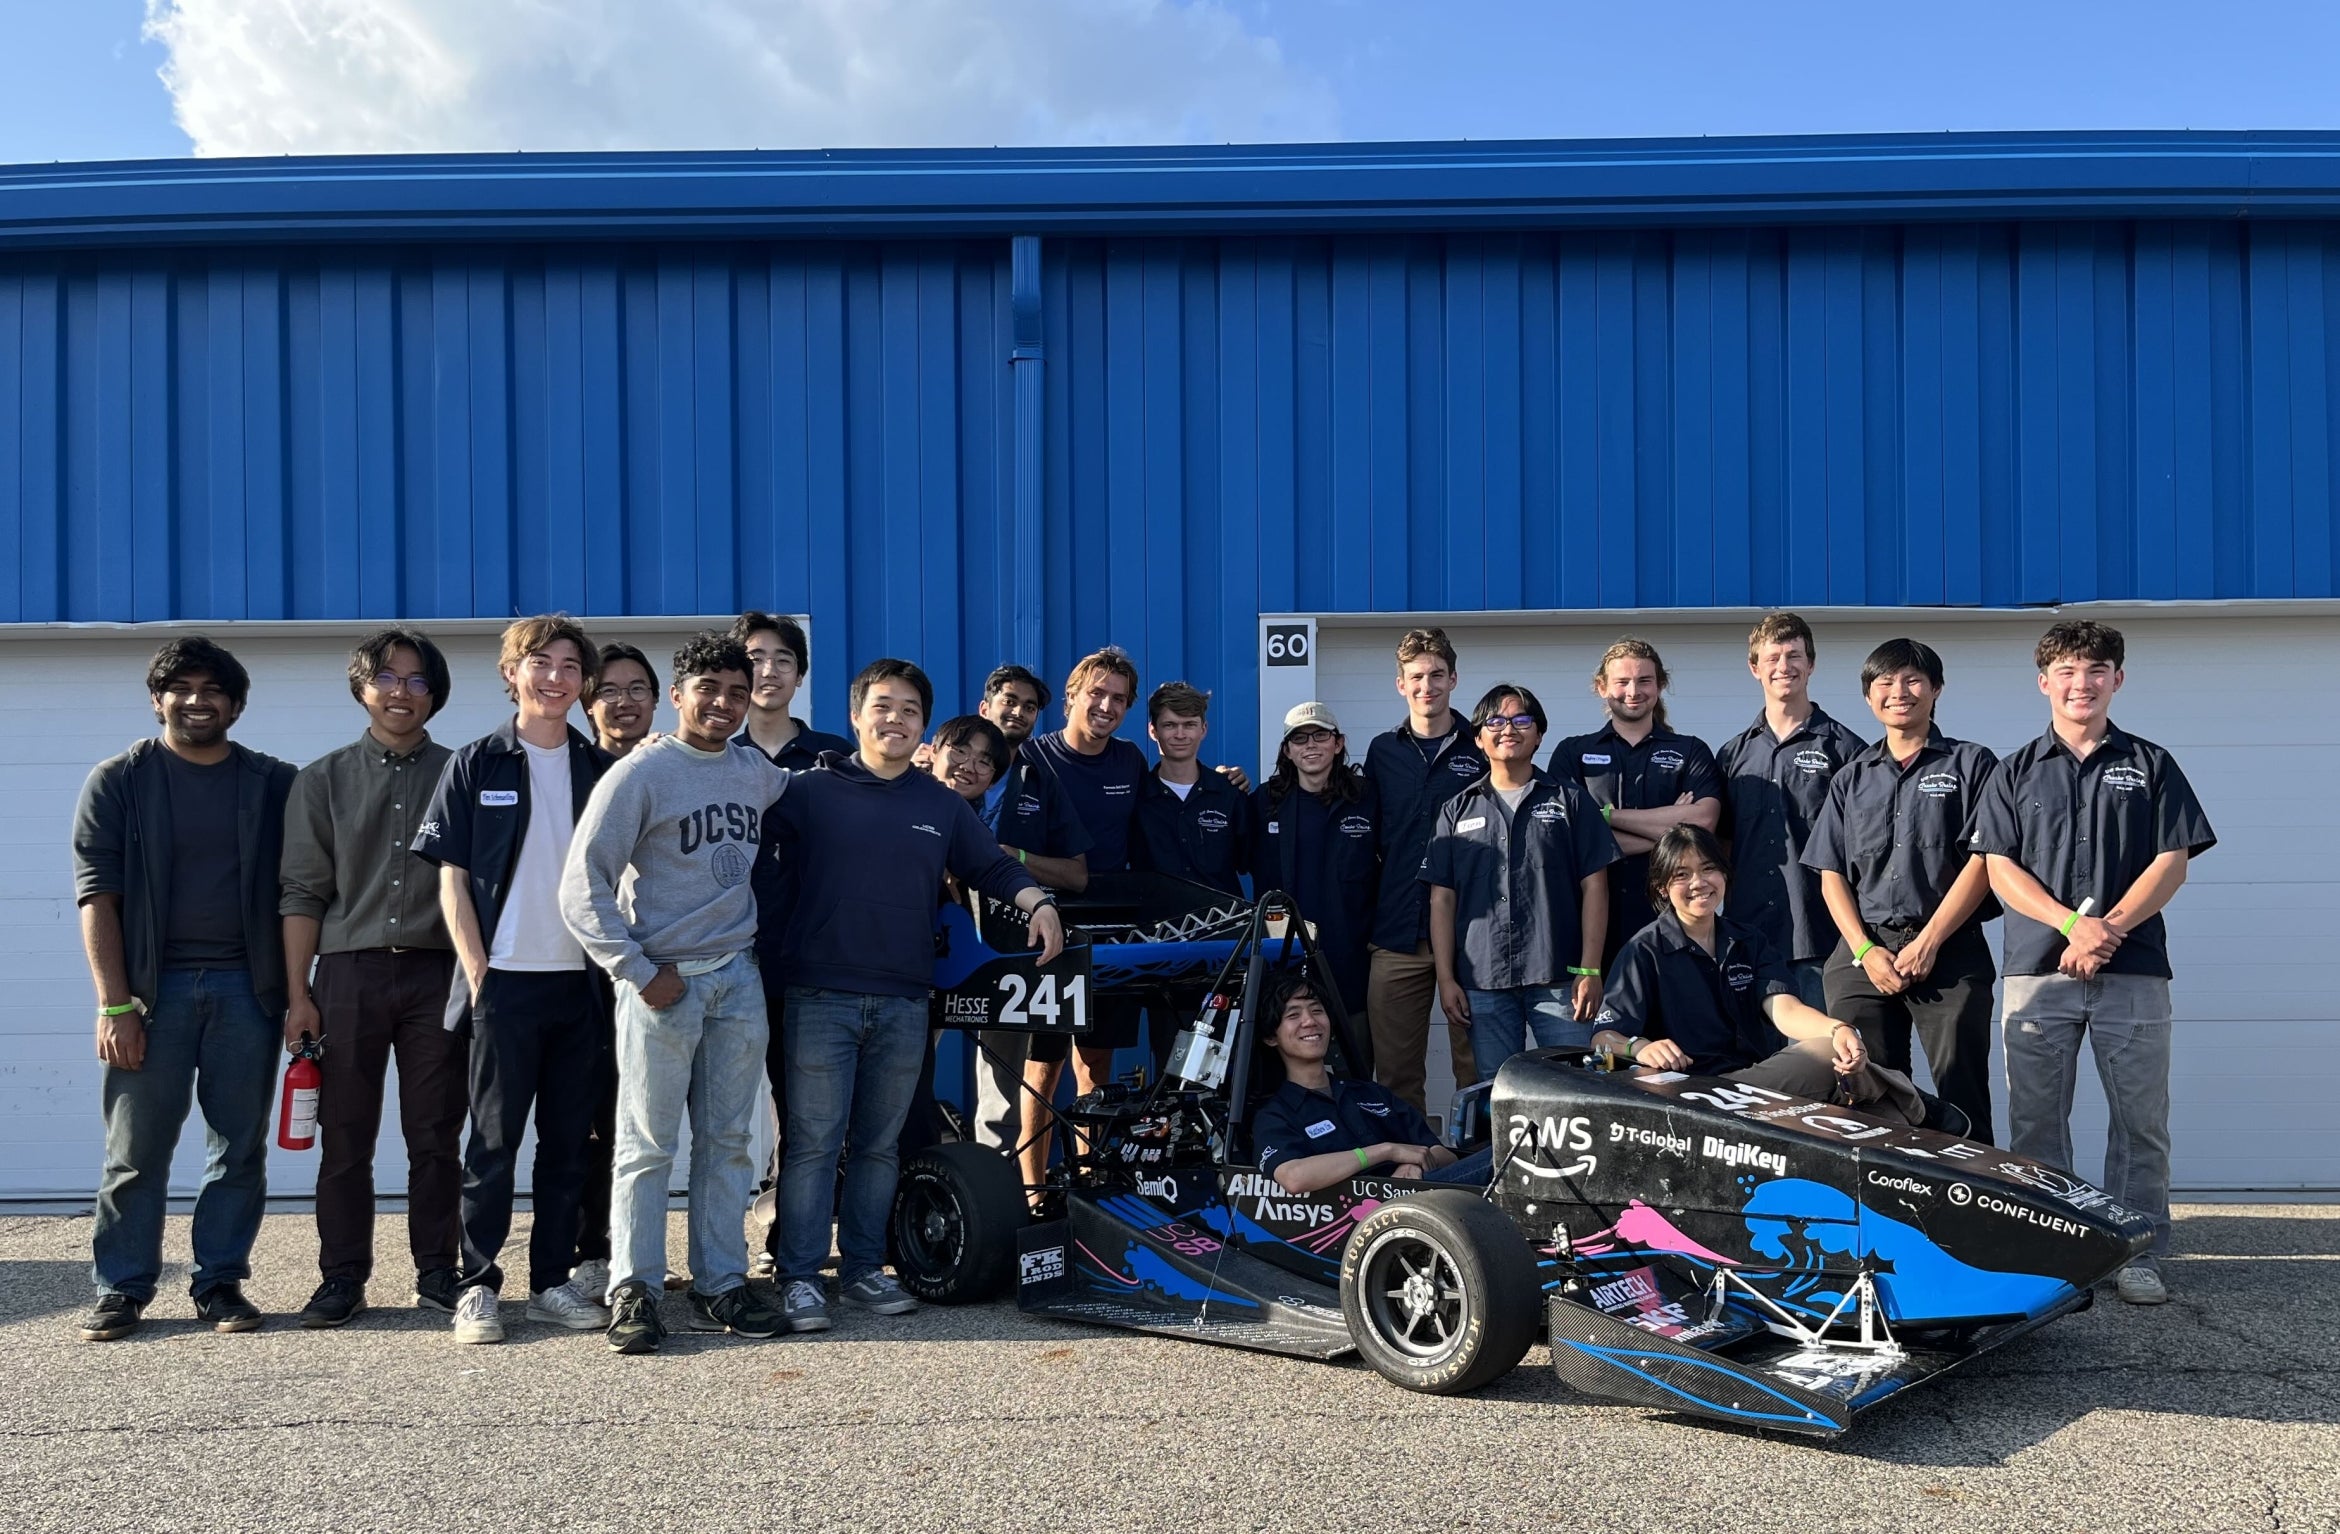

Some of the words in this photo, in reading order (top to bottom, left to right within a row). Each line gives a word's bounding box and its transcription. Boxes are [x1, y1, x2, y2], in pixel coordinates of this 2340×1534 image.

[1267, 633, 1308, 658] 60
[680, 802, 760, 856] UCSB
[998, 973, 1087, 1026] 241
[944, 1015, 989, 1024] MECHATRONICS
[1679, 1083, 1793, 1111] 241
[1509, 1114, 1593, 1152] aws
[1703, 1135, 1787, 1177] DigiKey
[1135, 1171, 1178, 1204] SemiQ
[1226, 1173, 1311, 1198] Altiu
[1351, 1180, 1379, 1198] UC
[1867, 1170, 1933, 1197] Coroflex
[1255, 1196, 1334, 1227] Ansys
[1976, 1194, 2091, 1239] CONFLUENT
[1173, 1236, 1222, 1256] SB
[1021, 1270, 1063, 1286] ENDS
[1030, 1262, 1063, 1276] ROD
[1589, 1274, 1653, 1309] AIRTECH
